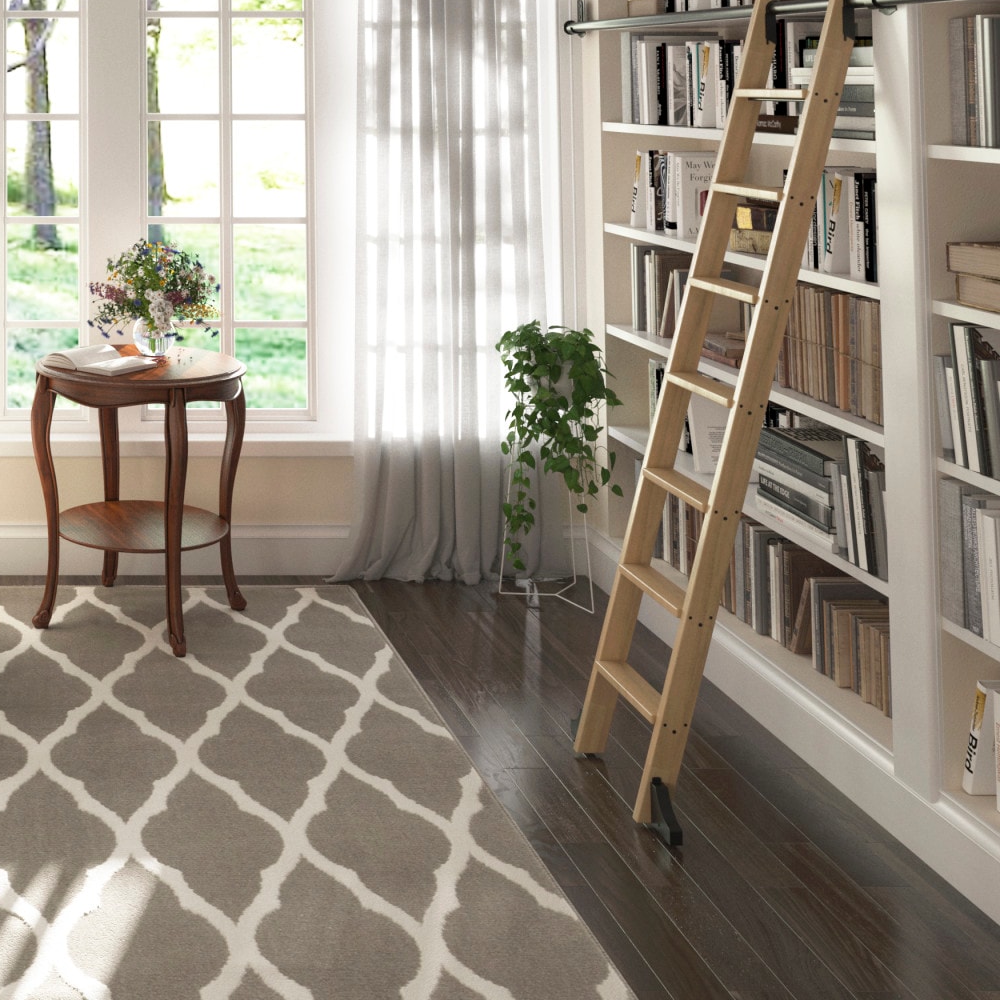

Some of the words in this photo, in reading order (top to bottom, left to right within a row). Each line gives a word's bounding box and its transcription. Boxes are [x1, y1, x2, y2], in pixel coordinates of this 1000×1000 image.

[686, 161, 701, 172] May
[690, 174, 712, 183] Forgi
[826, 219, 836, 254] Bird
[780, 485, 790, 499] EDGE
[965, 733, 978, 774] Bird
